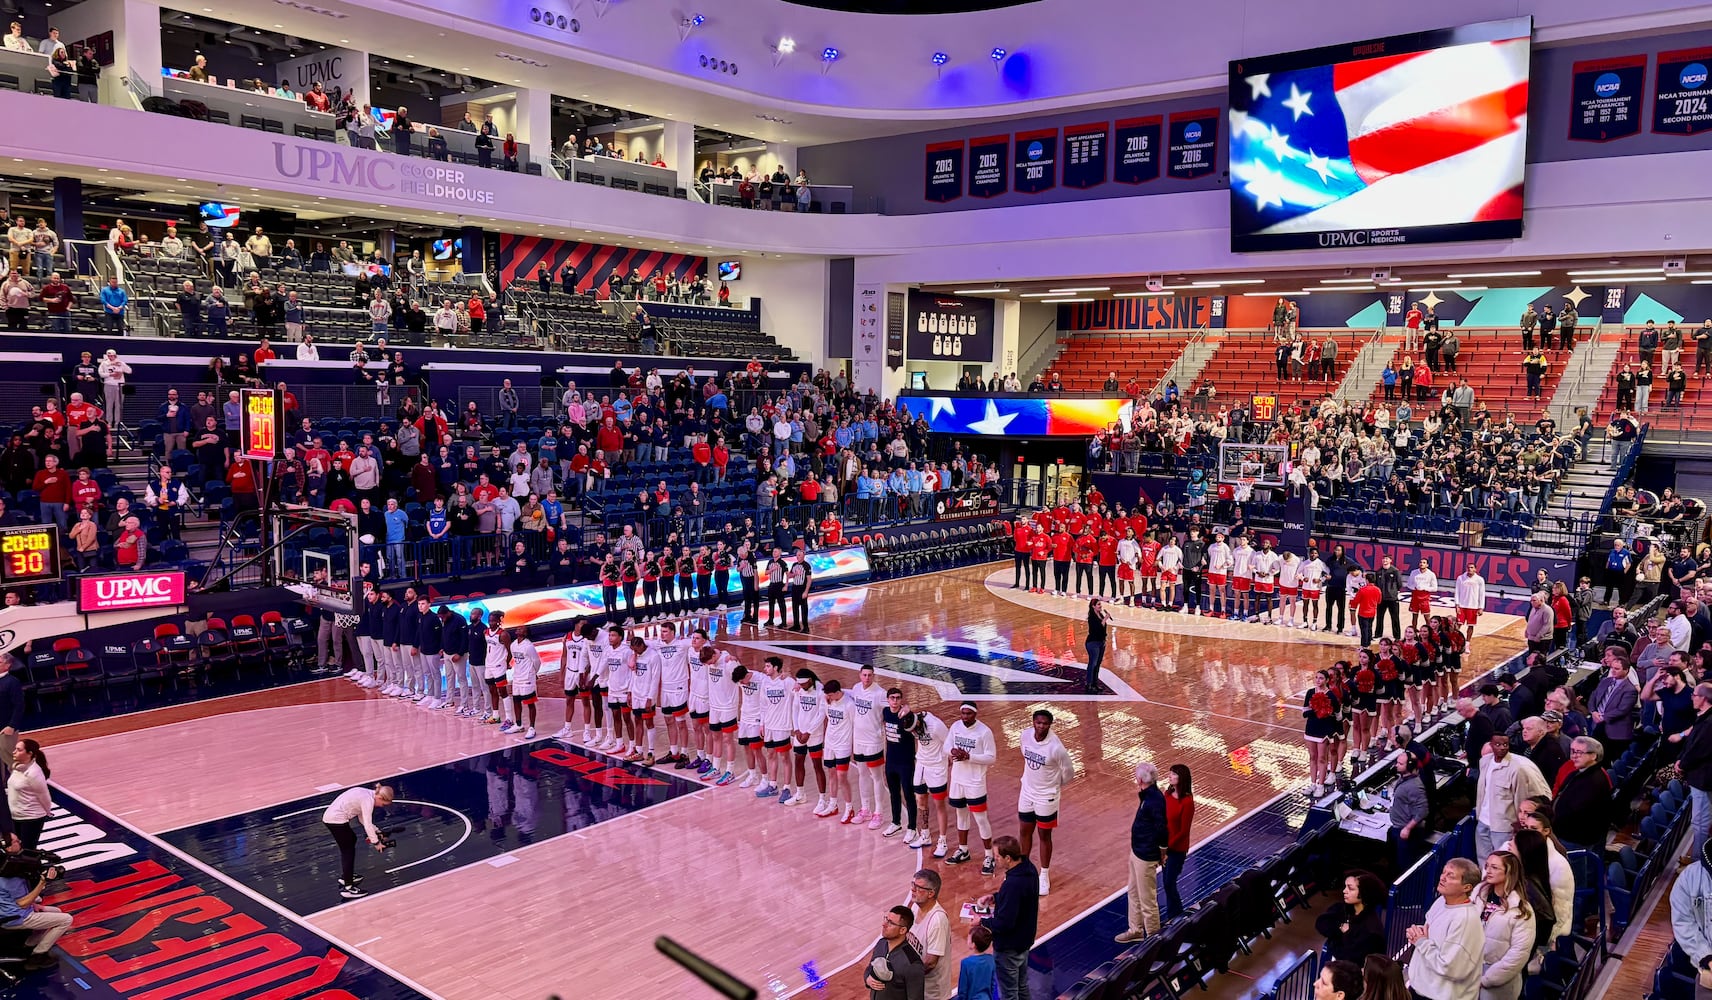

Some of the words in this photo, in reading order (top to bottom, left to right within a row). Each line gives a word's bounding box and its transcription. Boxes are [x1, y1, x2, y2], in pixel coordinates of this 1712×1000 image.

[297, 57, 342, 87] UPMC
[1682, 74, 1707, 84] NCAA
[1596, 83, 1620, 92] NCAA
[1596, 96, 1631, 105] TOURNAMENT
[1658, 92, 1678, 100] NCAA
[1675, 97, 1707, 115] 2024
[1663, 115, 1691, 124] SECOND
[1127, 136, 1148, 151] 2016
[979, 153, 997, 168] 2013
[1182, 150, 1202, 163] 2016
[272, 141, 395, 191] UPMC
[400, 162, 465, 184] COOPER
[936, 159, 953, 173] 2013
[1027, 166, 1043, 179] 2013
[400, 179, 495, 204] FIELDHOUSE
[1319, 231, 1365, 246] UPMC
[1371, 229, 1400, 237] SPORTS
[1371, 235, 1405, 243] MEDICINE
[1391, 295, 1402, 305] 214
[1608, 288, 1621, 299] 213
[1607, 298, 1620, 308] 214
[248, 396, 273, 415] 20:00
[1256, 405, 1271, 419] 30
[253, 418, 271, 450] 30
[1284, 522, 1305, 531] UPMC
[2, 533, 48, 552] 20:00
[14, 552, 43, 575] 30
[1420, 550, 1530, 588] DUKES
[96, 577, 171, 599] UPMC
[105, 645, 126, 653] UPMC
